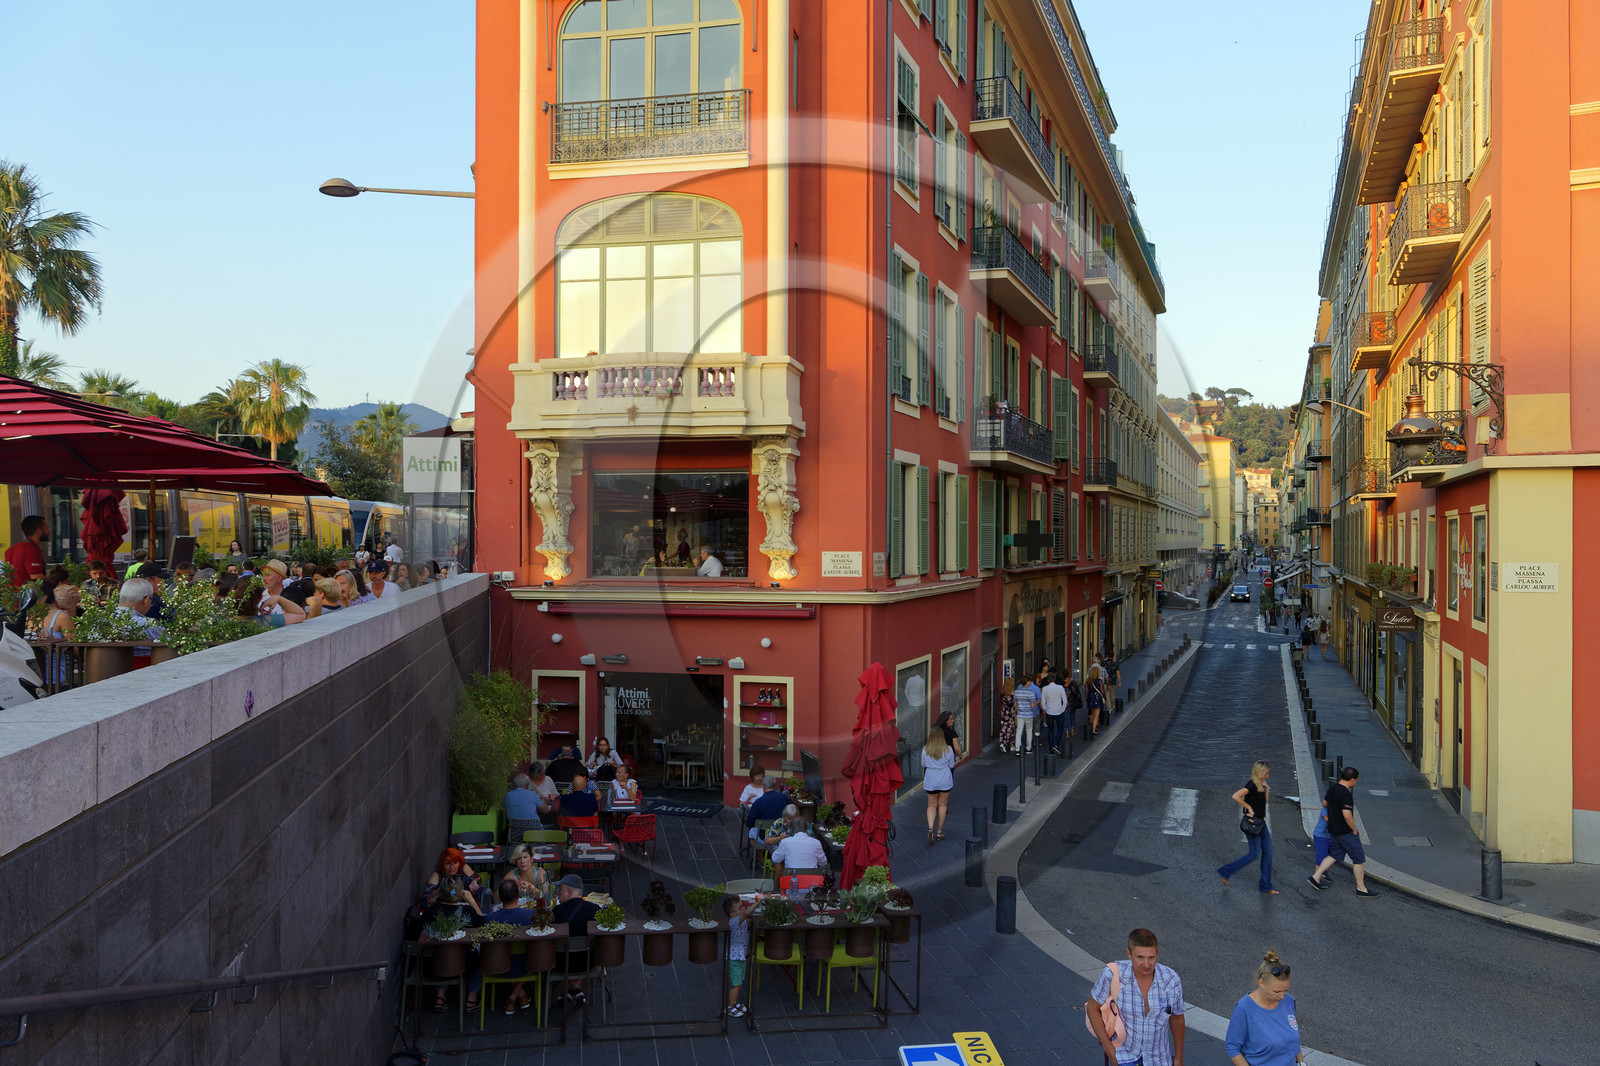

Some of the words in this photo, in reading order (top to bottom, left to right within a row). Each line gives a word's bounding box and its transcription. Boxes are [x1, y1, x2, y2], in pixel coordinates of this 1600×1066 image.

[407, 455, 458, 472] Attimi
[273, 518, 288, 533] TOUS
[618, 686, 649, 699] Attimi
[608, 698, 652, 709] OUVERT
[653, 805, 711, 814] Attimi
